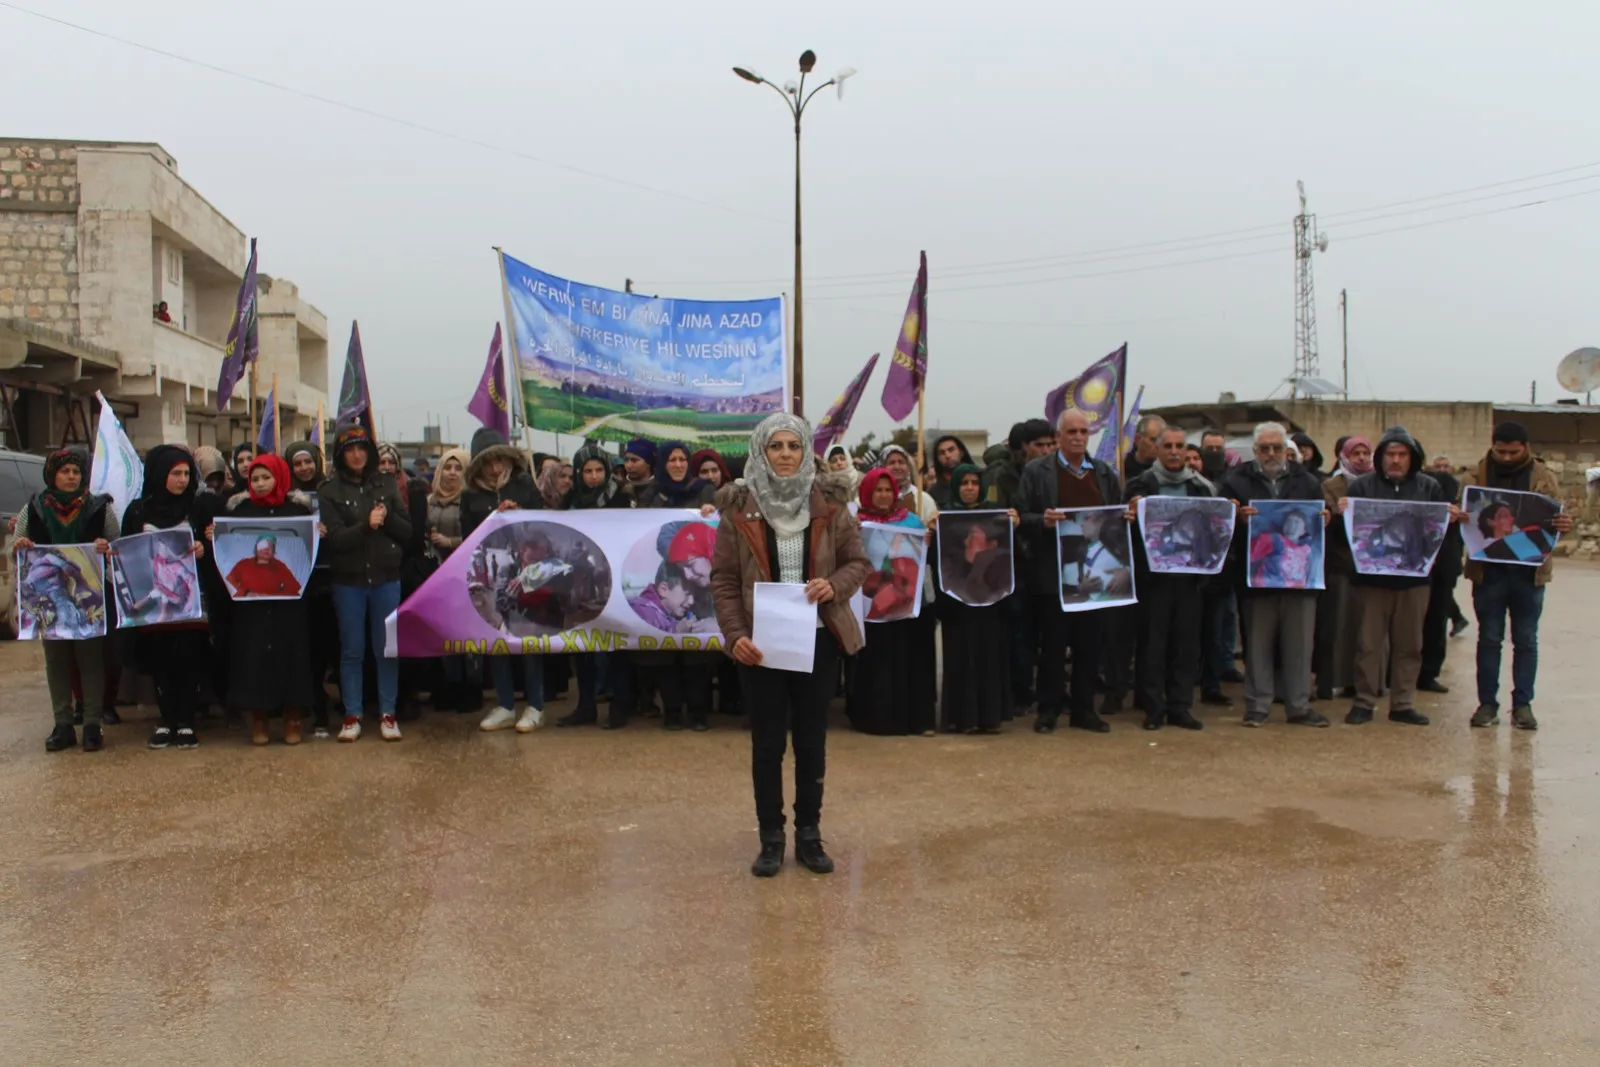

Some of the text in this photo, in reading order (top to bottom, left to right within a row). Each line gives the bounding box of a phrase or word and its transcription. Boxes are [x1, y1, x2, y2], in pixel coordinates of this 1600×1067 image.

[581, 297, 605, 317] EM
[612, 303, 626, 321] BI
[677, 313, 713, 329] JINA
[719, 312, 763, 329] AZAD
